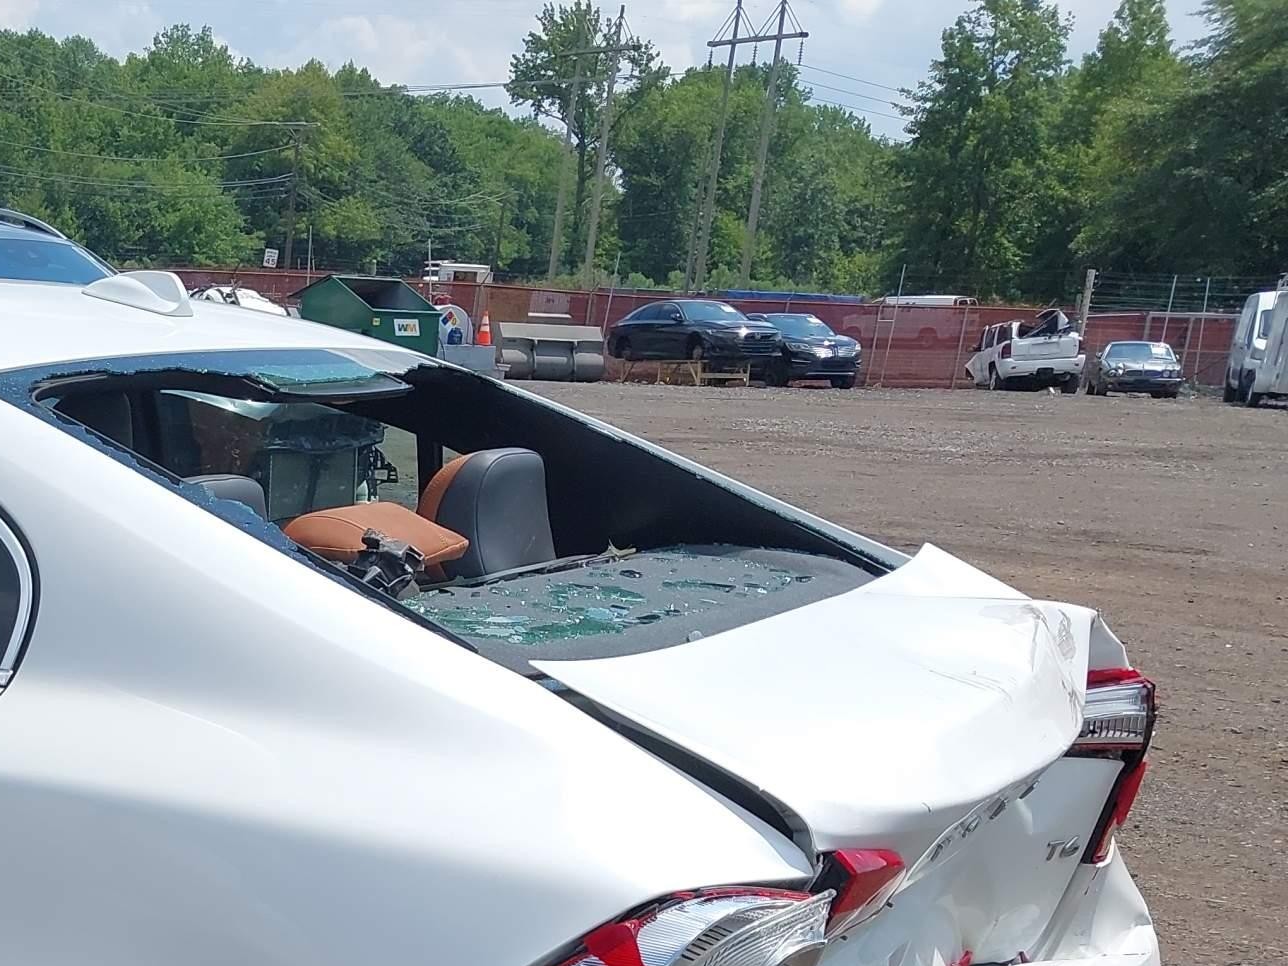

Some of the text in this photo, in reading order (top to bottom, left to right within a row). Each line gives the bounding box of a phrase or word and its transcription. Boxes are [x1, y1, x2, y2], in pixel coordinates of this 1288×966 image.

[265, 257, 277, 266] 45
[397, 323, 417, 332] WM
[1045, 834, 1081, 861] T6
